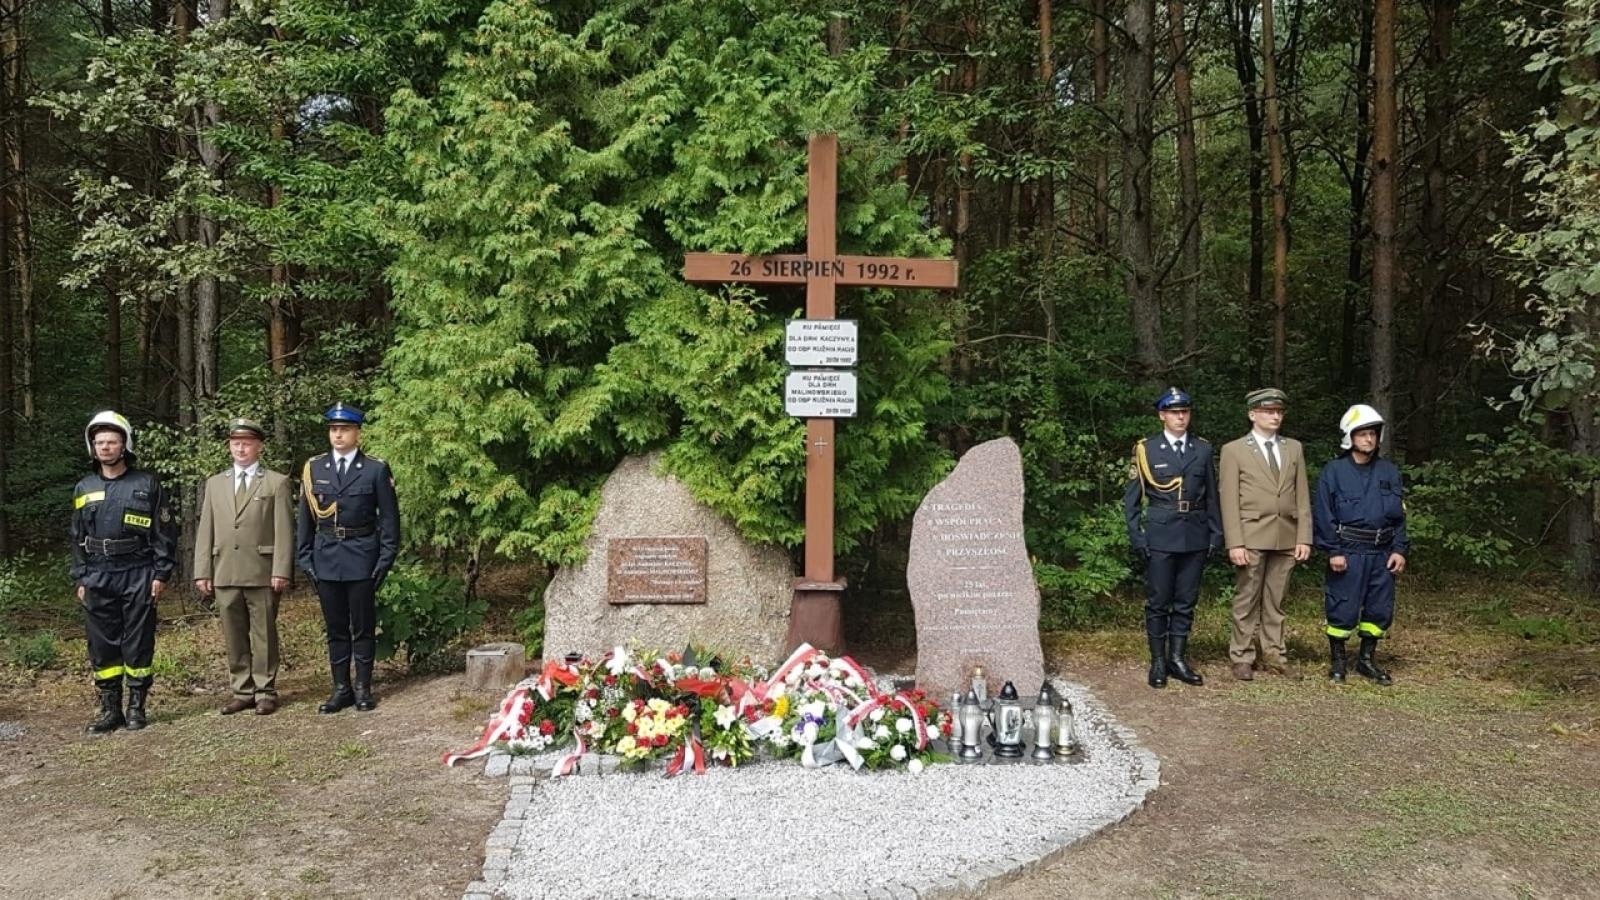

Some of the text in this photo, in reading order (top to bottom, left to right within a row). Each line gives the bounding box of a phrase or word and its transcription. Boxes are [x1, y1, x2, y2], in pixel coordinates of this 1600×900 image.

[730, 259, 915, 280] 26 SIERPIEŃ 1992 r.
[931, 503, 982, 511] TRAGEDIA
